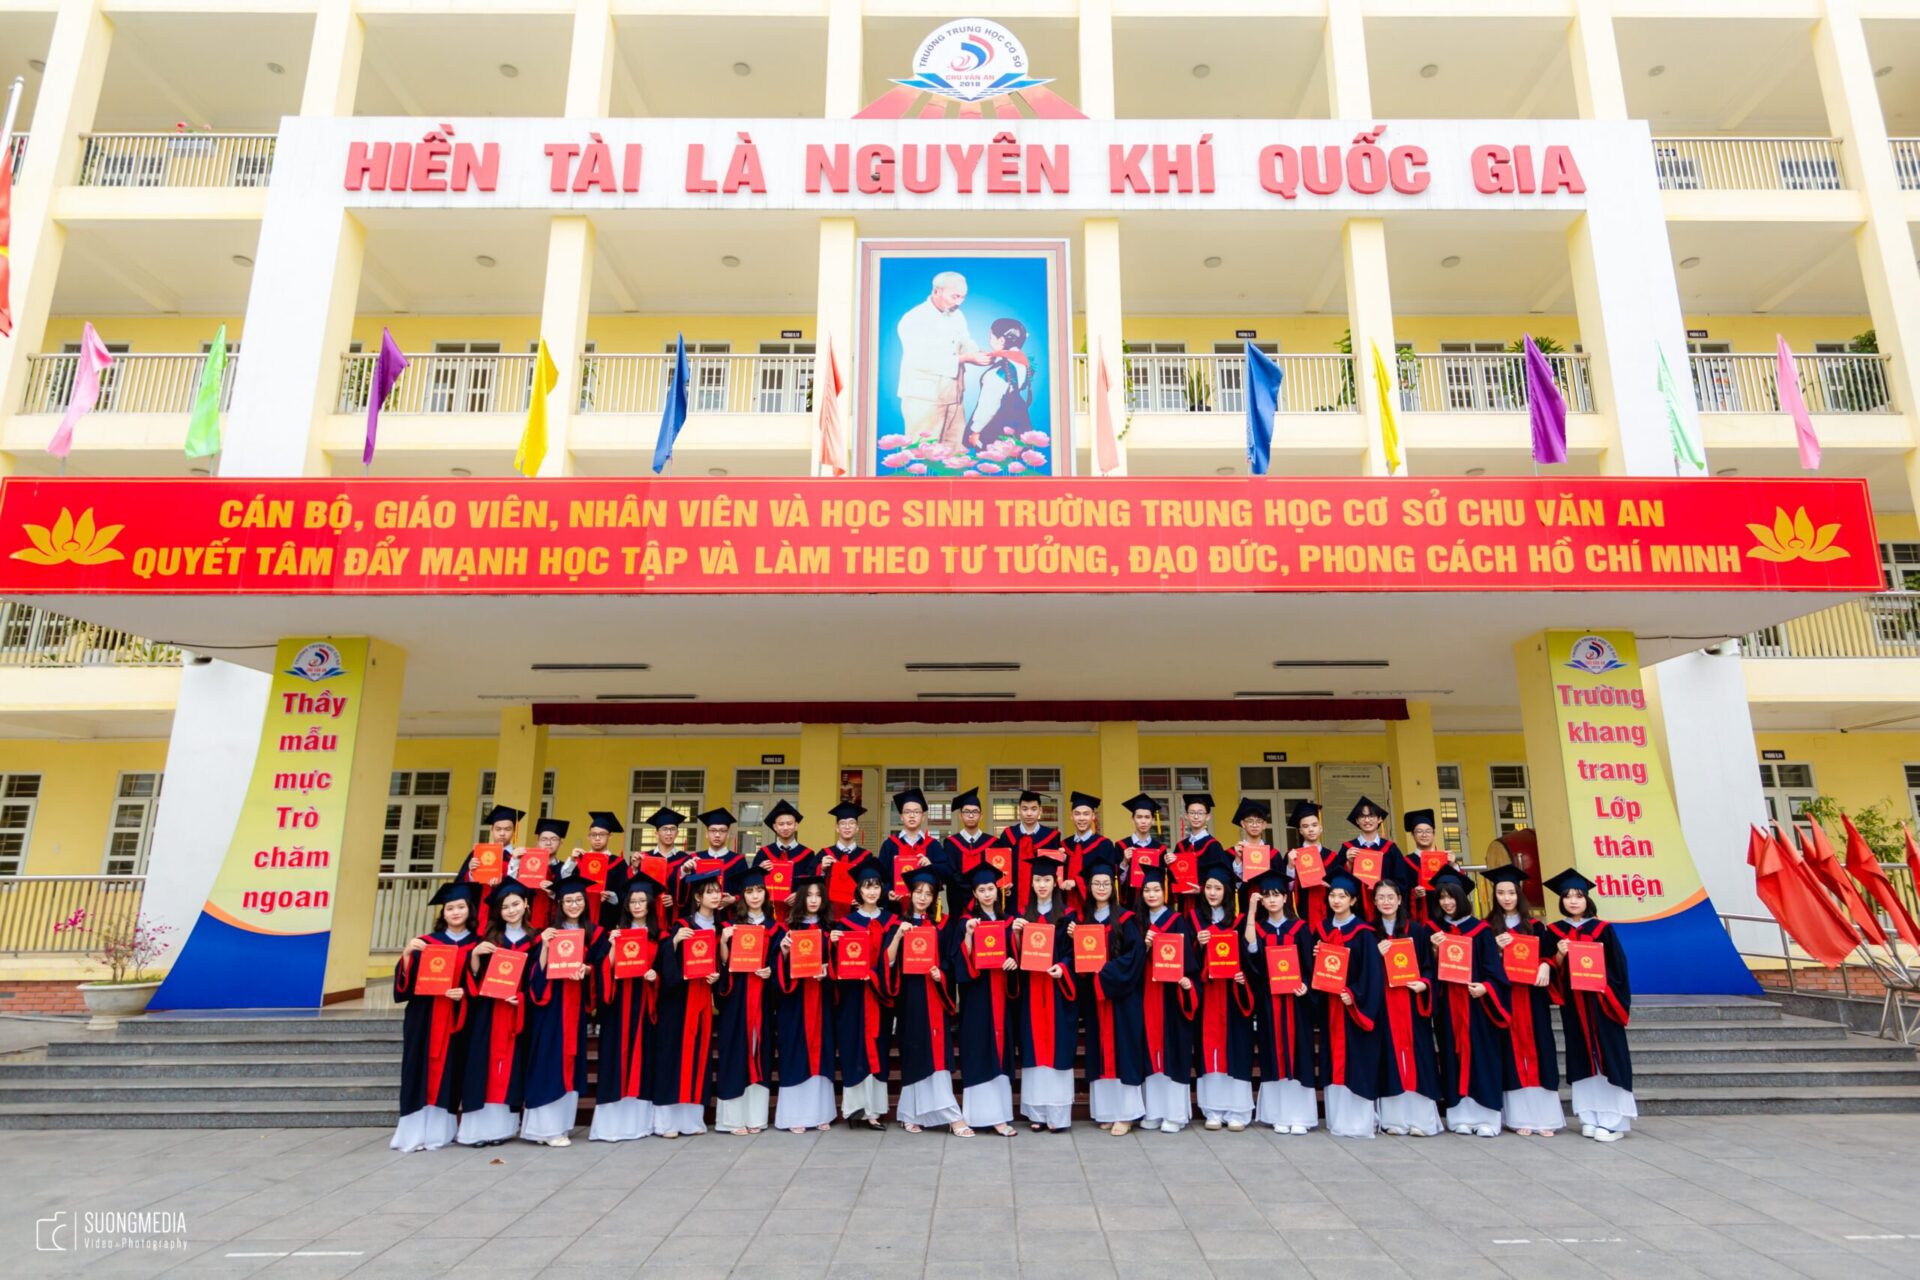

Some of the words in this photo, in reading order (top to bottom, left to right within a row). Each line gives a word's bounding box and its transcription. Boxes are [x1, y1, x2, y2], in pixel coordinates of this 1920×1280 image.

[946, 26, 982, 36] TRUNG
[984, 28, 1006, 41] HỌC
[344, 124, 500, 192] HIỀN
[544, 132, 643, 194] TÀI
[685, 132, 767, 194] LÀ
[805, 132, 1070, 194] NGUYÊN
[1109, 133, 1216, 194] KHÍ
[1259, 125, 1432, 199] QUỐC
[1471, 144, 1587, 195] GIA
[219, 494, 294, 528] CÁN
[304, 494, 363, 533] BỘ,
[374, 495, 457, 528] GIÁO
[468, 494, 558, 531] VIÊN,
[569, 494, 668, 528] NHÂN
[678, 494, 758, 528] VIÊN
[769, 494, 810, 528] VÀ
[820, 499, 890, 533] HỌC
[902, 499, 985, 528] SINH
[995, 493, 1131, 528] TRƯỜNG
[1141, 499, 1253, 528] TRUNG
[1264, 498, 1332, 533] HỌC
[1343, 496, 1388, 527] CƠ
[1402, 488, 1447, 527] SỞ
[1457, 498, 1526, 527] CHU
[1535, 493, 1605, 527] VĂN
[1618, 499, 1664, 527] AN
[132, 538, 246, 578] QUYẾT
[257, 541, 332, 576] TÂM
[344, 535, 409, 576] ĐẨY
[419, 547, 528, 582] MẠNH
[539, 546, 610, 582] HỌC
[621, 540, 688, 580] TẬP
[699, 540, 739, 575] VÀ
[755, 540, 831, 575] LÀM
[842, 545, 930, 575] THEO
[940, 544, 987, 574] TƯ
[994, 534, 1119, 577] TƯỞNG,
[1128, 545, 1198, 579] ĐẠO
[1208, 539, 1290, 576] ĐỨC,
[1299, 545, 1416, 573] PHONG
[1426, 539, 1518, 573] CÁCH
[1528, 536, 1575, 573] HỒ
[1585, 539, 1642, 573] CHÍ
[1650, 545, 1741, 573] MINH
[282, 690, 347, 718] Thầy
[1557, 683, 1647, 710] Trường
[279, 726, 338, 752] mẫu
[1568, 721, 1647, 747] khang
[273, 769, 332, 795] mực
[1577, 759, 1648, 785] trang
[276, 806, 320, 829] Trò
[1594, 795, 1642, 823] Lớp
[254, 846, 330, 869] chăm
[1593, 834, 1654, 858] thân
[1594, 873, 1663, 902] thiện
[242, 889, 331, 913] ngoan
